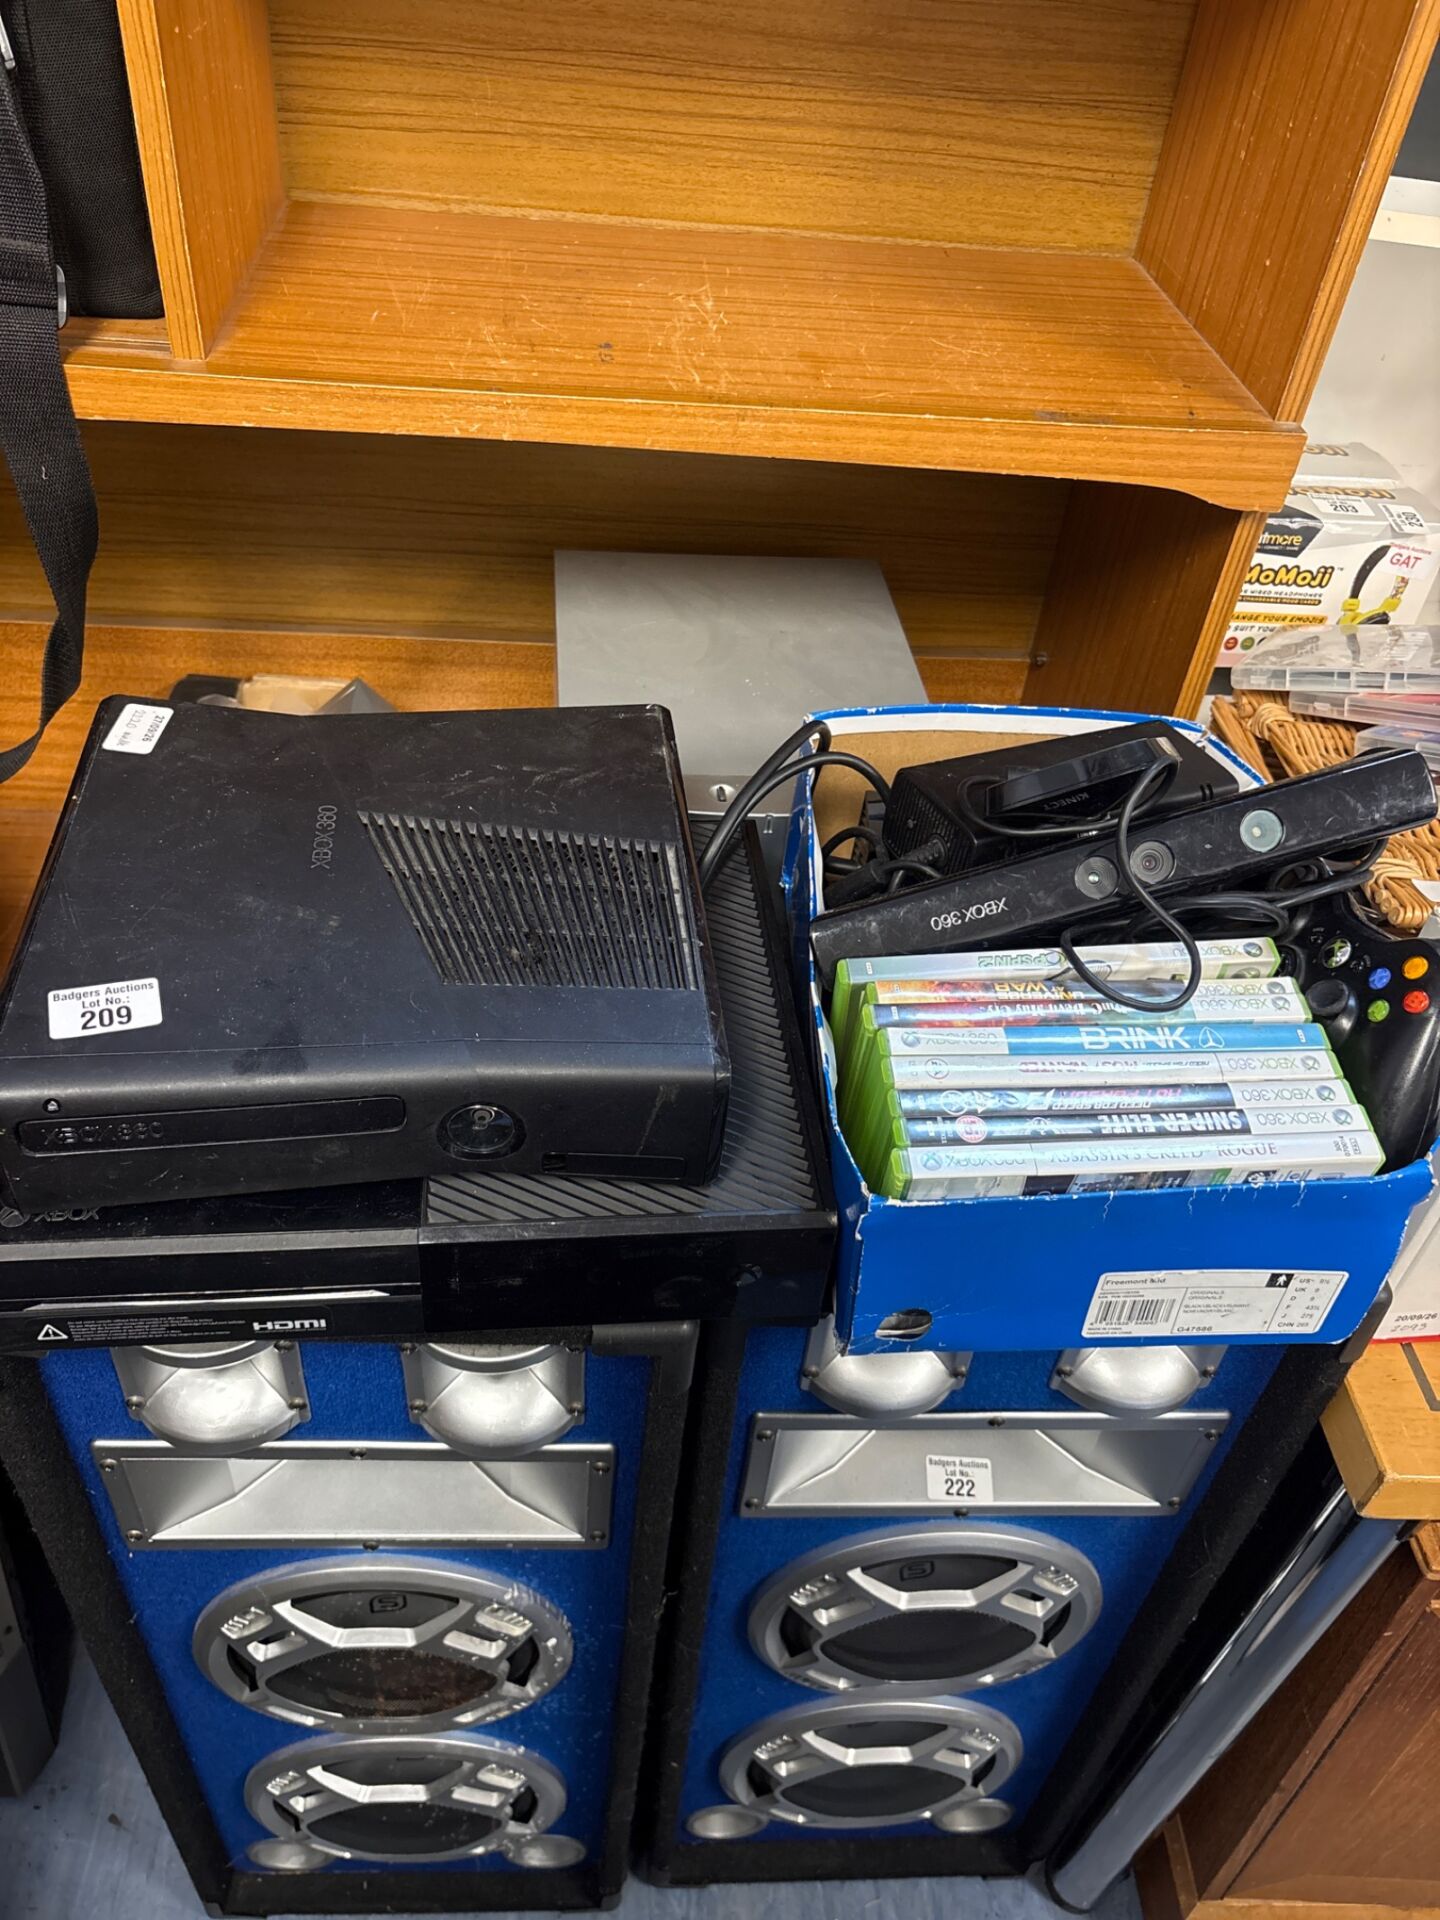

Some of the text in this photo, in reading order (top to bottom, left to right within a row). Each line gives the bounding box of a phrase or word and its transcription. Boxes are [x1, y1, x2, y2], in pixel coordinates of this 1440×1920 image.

[1330, 503, 1359, 514] 203
[1401, 511, 1424, 528] 230
[1389, 552, 1422, 569] GAT
[1043, 791, 1090, 811] KINECT
[53, 982, 154, 1002] Badgers Auctions
[994, 981, 1046, 992] WAR
[82, 996, 130, 1009] Lot No.:
[80, 1005, 132, 1030] 209
[1078, 1026, 1192, 1050] BRINK
[1096, 1109, 1244, 1134] SNIPER ELITE
[1217, 1142, 1279, 1158] ROGUE
[253, 1318, 327, 1331] HDMI
[1393, 1312, 1438, 1322] 20/09/26
[928, 1457, 989, 1469] Badgers Auctions
[945, 1468, 957, 1477] Lot
[944, 1477, 976, 1497] 222
